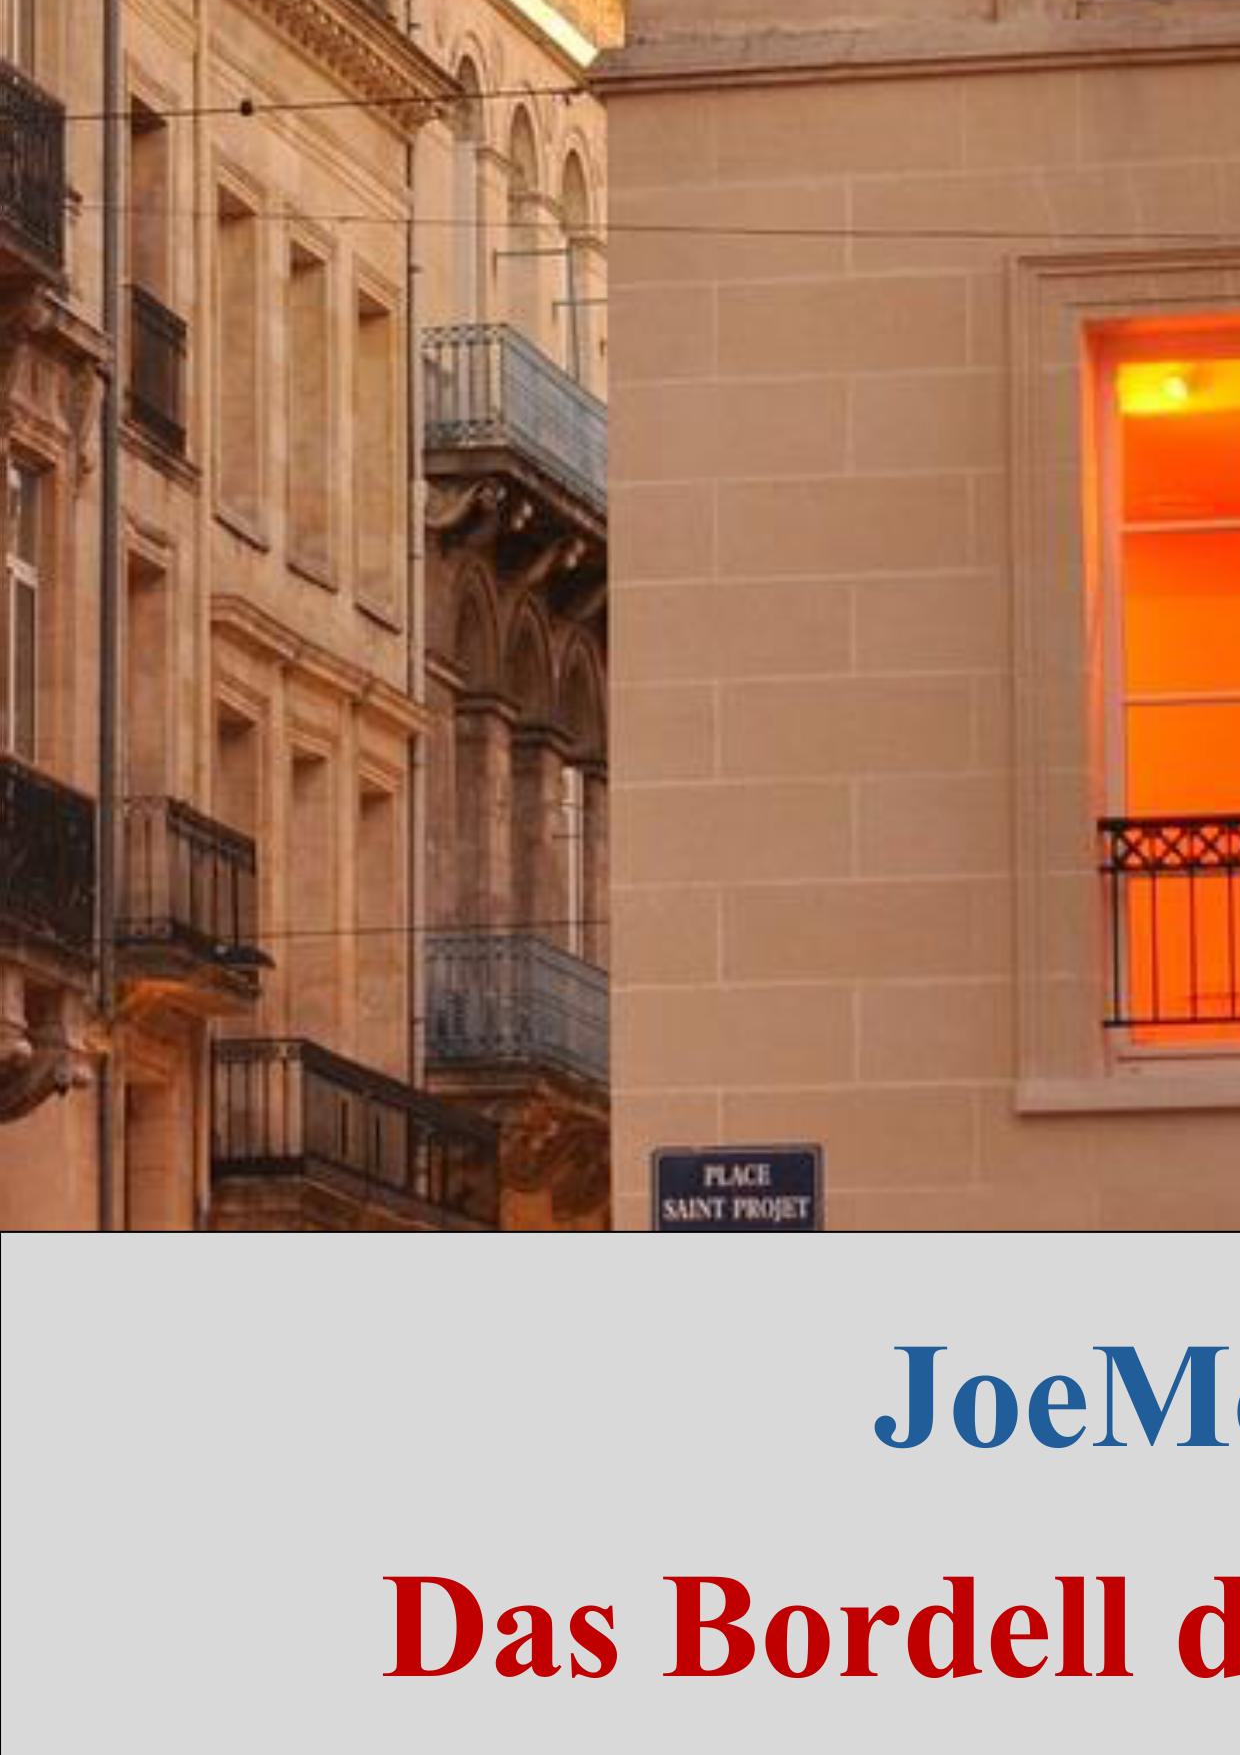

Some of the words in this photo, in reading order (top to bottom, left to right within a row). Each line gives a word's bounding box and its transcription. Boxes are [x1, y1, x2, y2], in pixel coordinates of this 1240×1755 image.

[703, 1163, 772, 1187] PLACE
[662, 1197, 725, 1220] SAINT
[733, 1197, 811, 1221] PROJET
